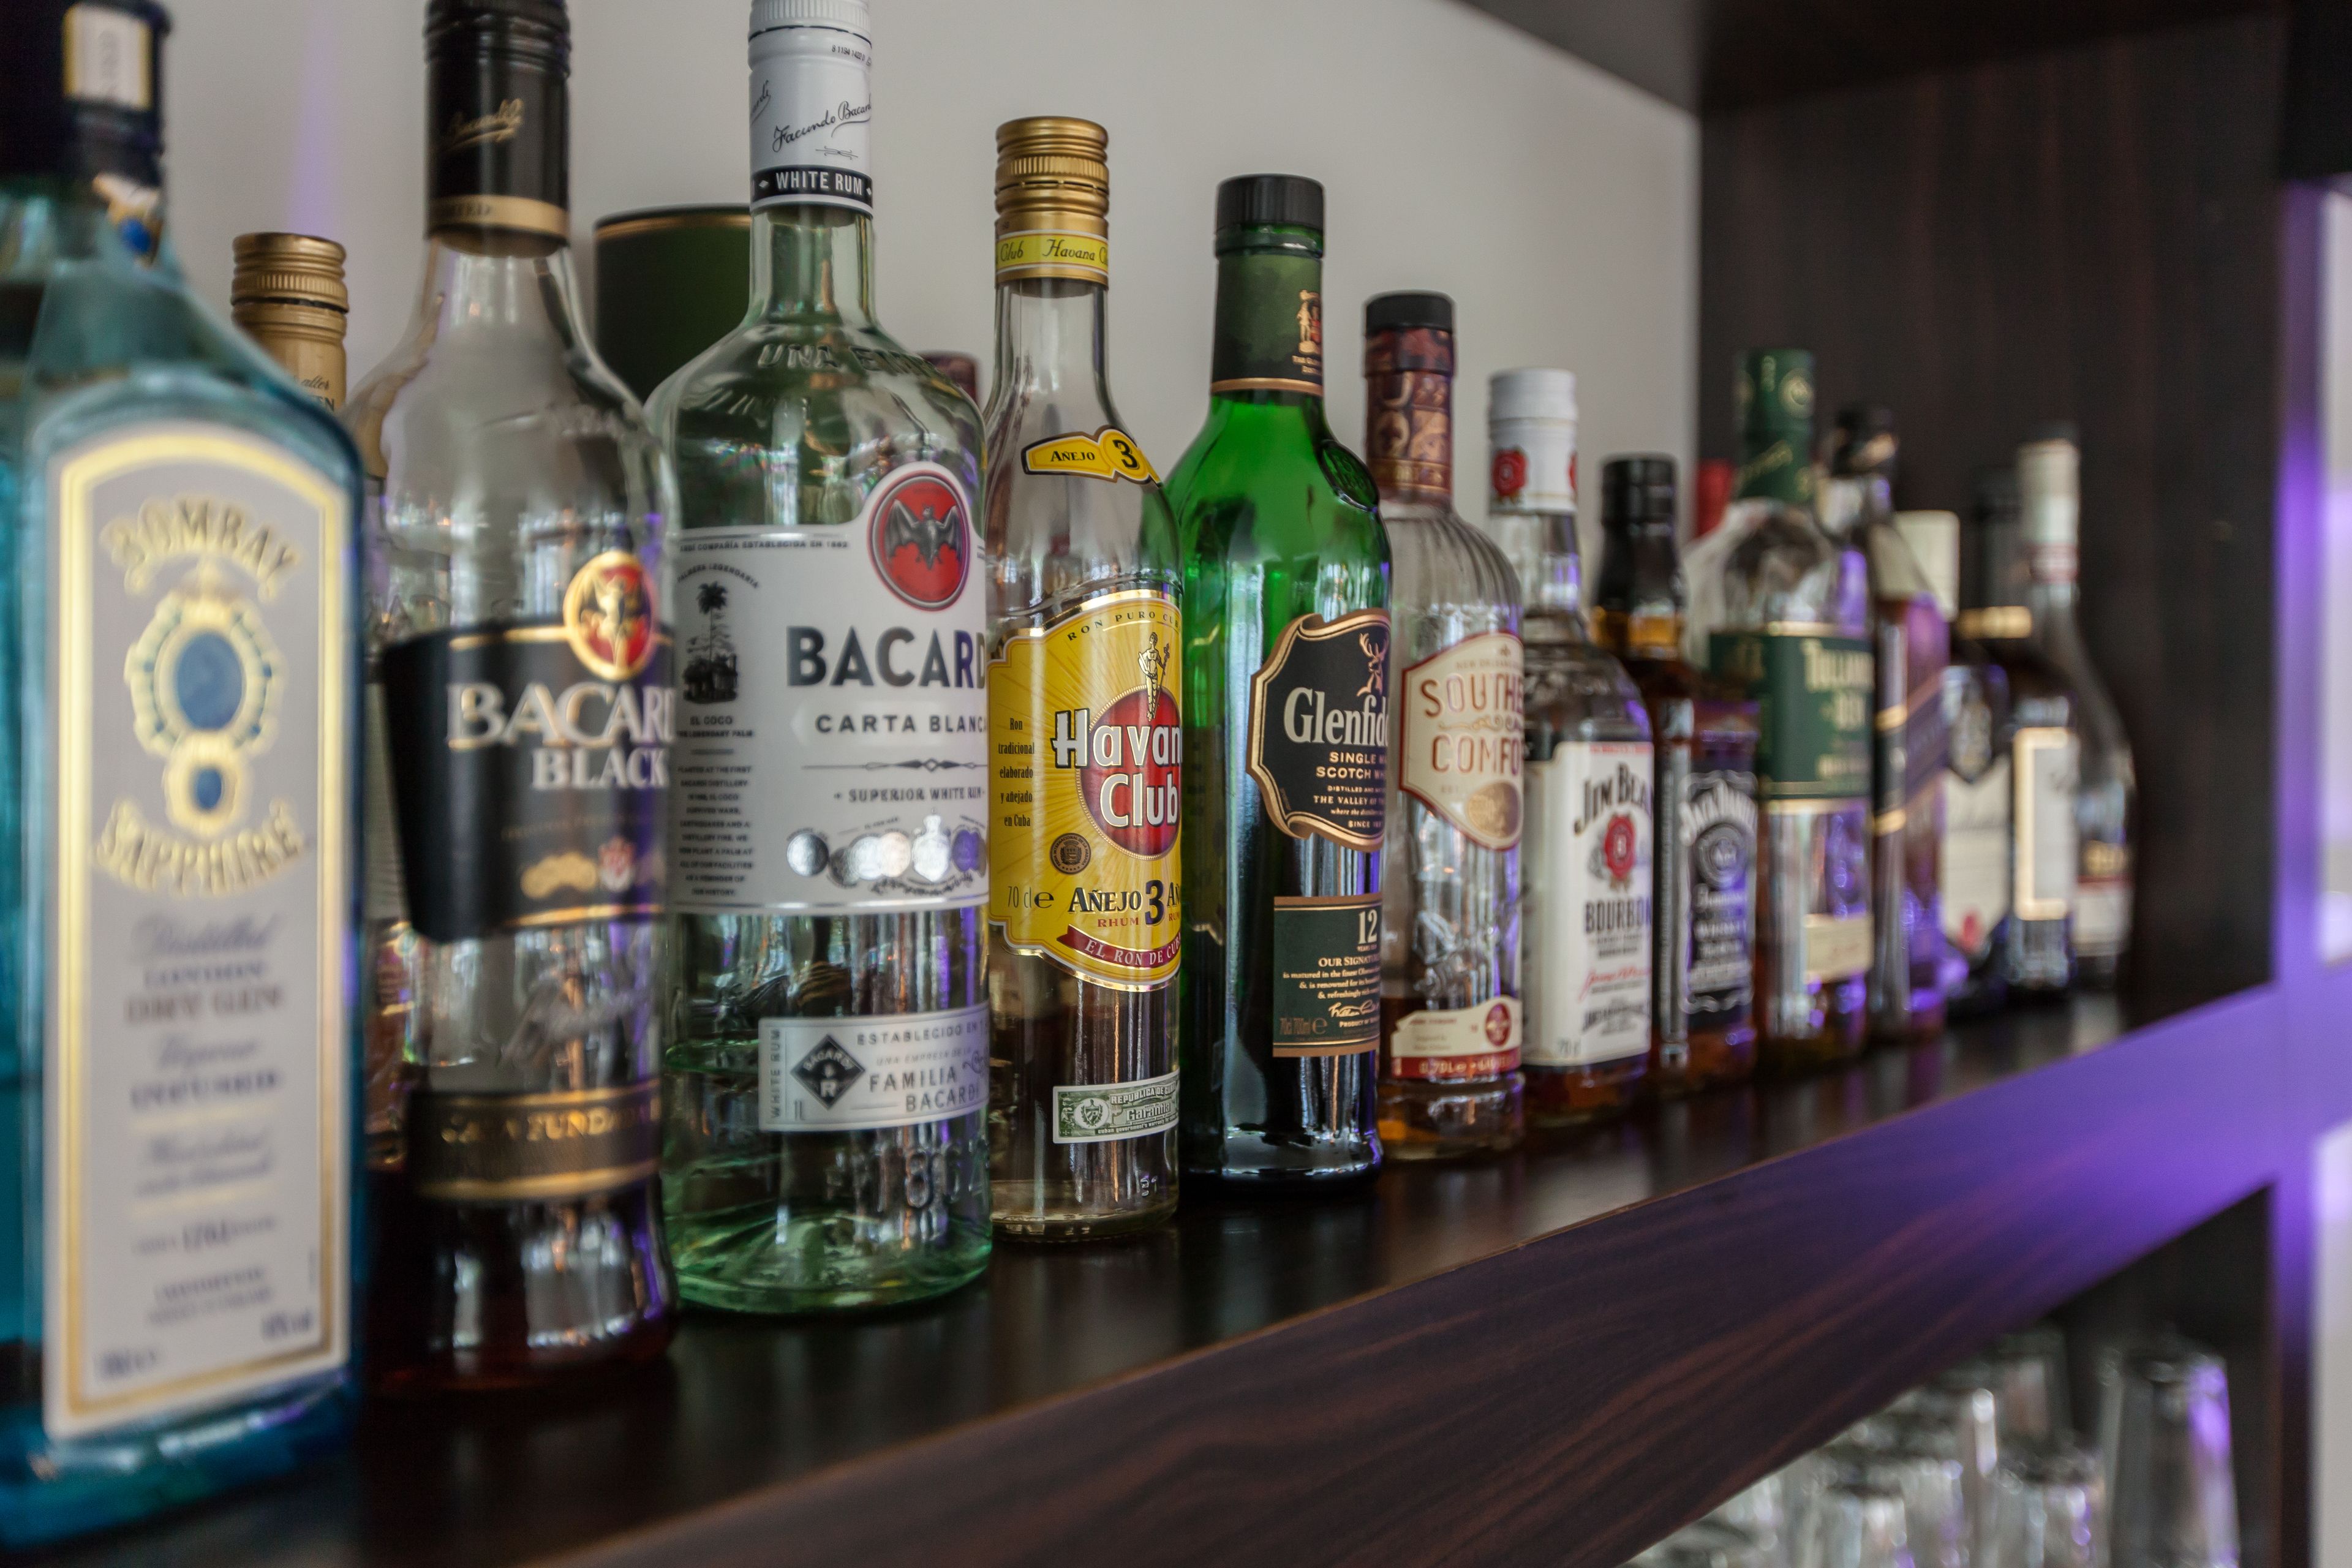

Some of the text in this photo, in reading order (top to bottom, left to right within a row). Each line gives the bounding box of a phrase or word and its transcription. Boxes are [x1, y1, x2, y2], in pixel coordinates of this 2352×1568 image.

[776, 171, 862, 195] WHITE RUM
[1000, 240, 1025, 262] Club
[1042, 239, 1095, 262] Havana
[1112, 439, 1140, 470] 3
[1067, 620, 1104, 641] RON
[1115, 611, 1156, 622] PURO
[815, 714, 916, 734] CARTA
[1009, 718, 1023, 730] Ron
[998, 742, 1035, 755] tradicional
[1329, 752, 1377, 764] SINGLE
[531, 748, 669, 790] BLACK
[1000, 766, 1033, 778] elaborado
[1316, 766, 1371, 779] SCOTCH
[848, 788, 925, 804] SUPERIOR
[930, 788, 964, 800] WHITE
[1006, 790, 1033, 804] añejado
[1099, 772, 1178, 827] Club
[1313, 795, 1334, 804] THE
[1337, 796, 1368, 805] VALLEY
[1005, 815, 1031, 827] en Cuba
[1008, 886, 1019, 908] 70
[1068, 887, 1143, 913] AÑEJO
[1145, 880, 1164, 925] 3
[1098, 918, 1139, 927] RHUM
[1358, 909, 1377, 944] 12
[1085, 940, 1106, 959] EL
[1114, 953, 1143, 965] RON
[1149, 951, 1163, 965] DE
[1318, 957, 1343, 967] OUR
[1317, 980, 1349, 989] renowned
[857, 1025, 962, 1046] ESTABLECIDO
[771, 1029, 780, 1118] WHITE RUM
[870, 1066, 957, 1093] FAMILIA
[820, 1079, 837, 1098] R
[1110, 1087, 1155, 1104] REPUBLICA
